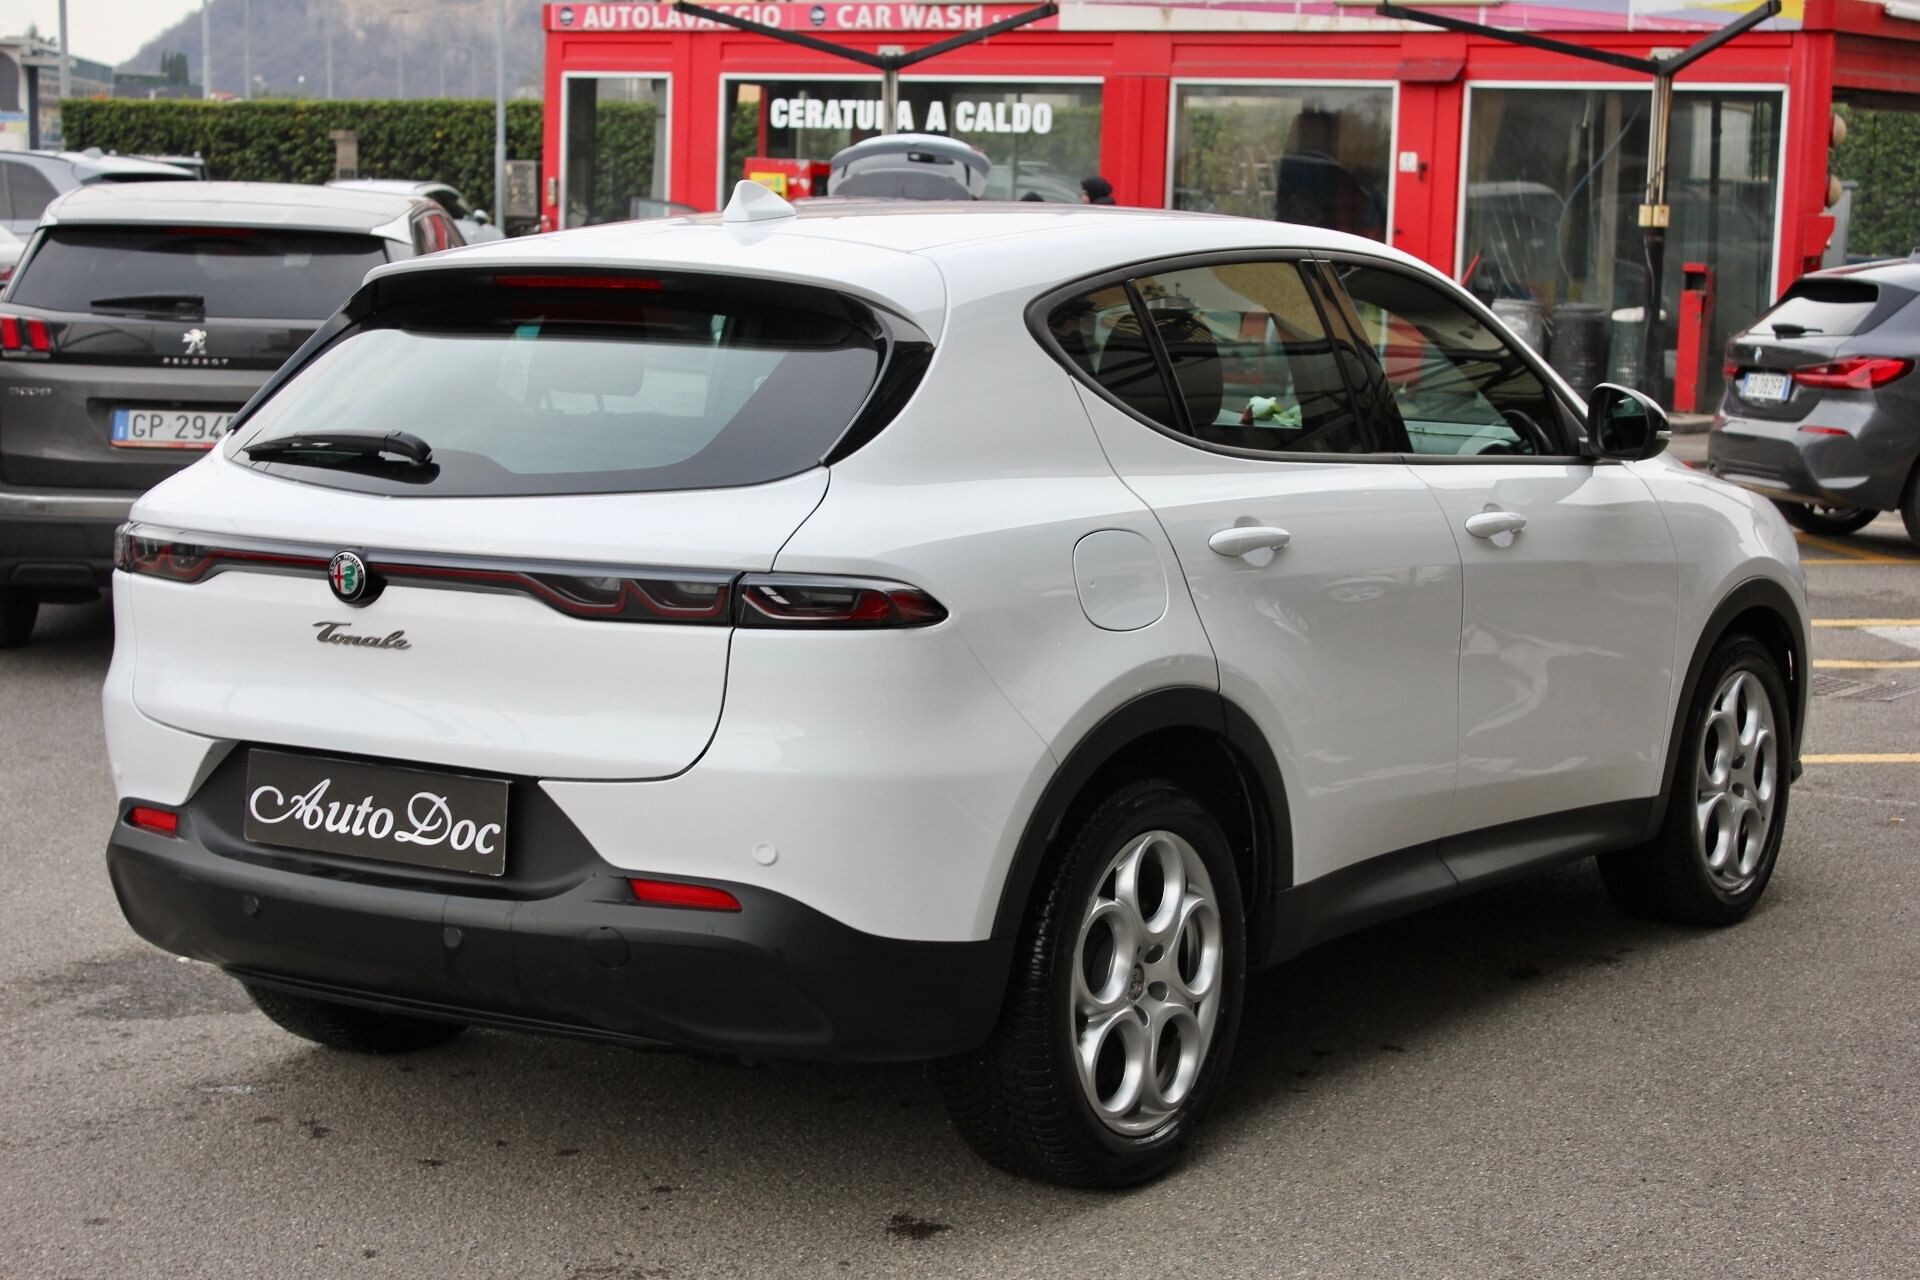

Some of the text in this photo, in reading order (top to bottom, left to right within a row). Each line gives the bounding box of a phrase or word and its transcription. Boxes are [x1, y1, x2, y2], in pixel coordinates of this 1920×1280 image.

[836, 5, 891, 29] CAR
[900, 5, 983, 29] WASH
[925, 100, 947, 132] A
[955, 101, 1052, 134] CALDO
[163, 357, 229, 365] PEUGEOT
[132, 414, 163, 438] GP
[312, 621, 412, 650] Tonale
[250, 778, 501, 854] Auto Doc
